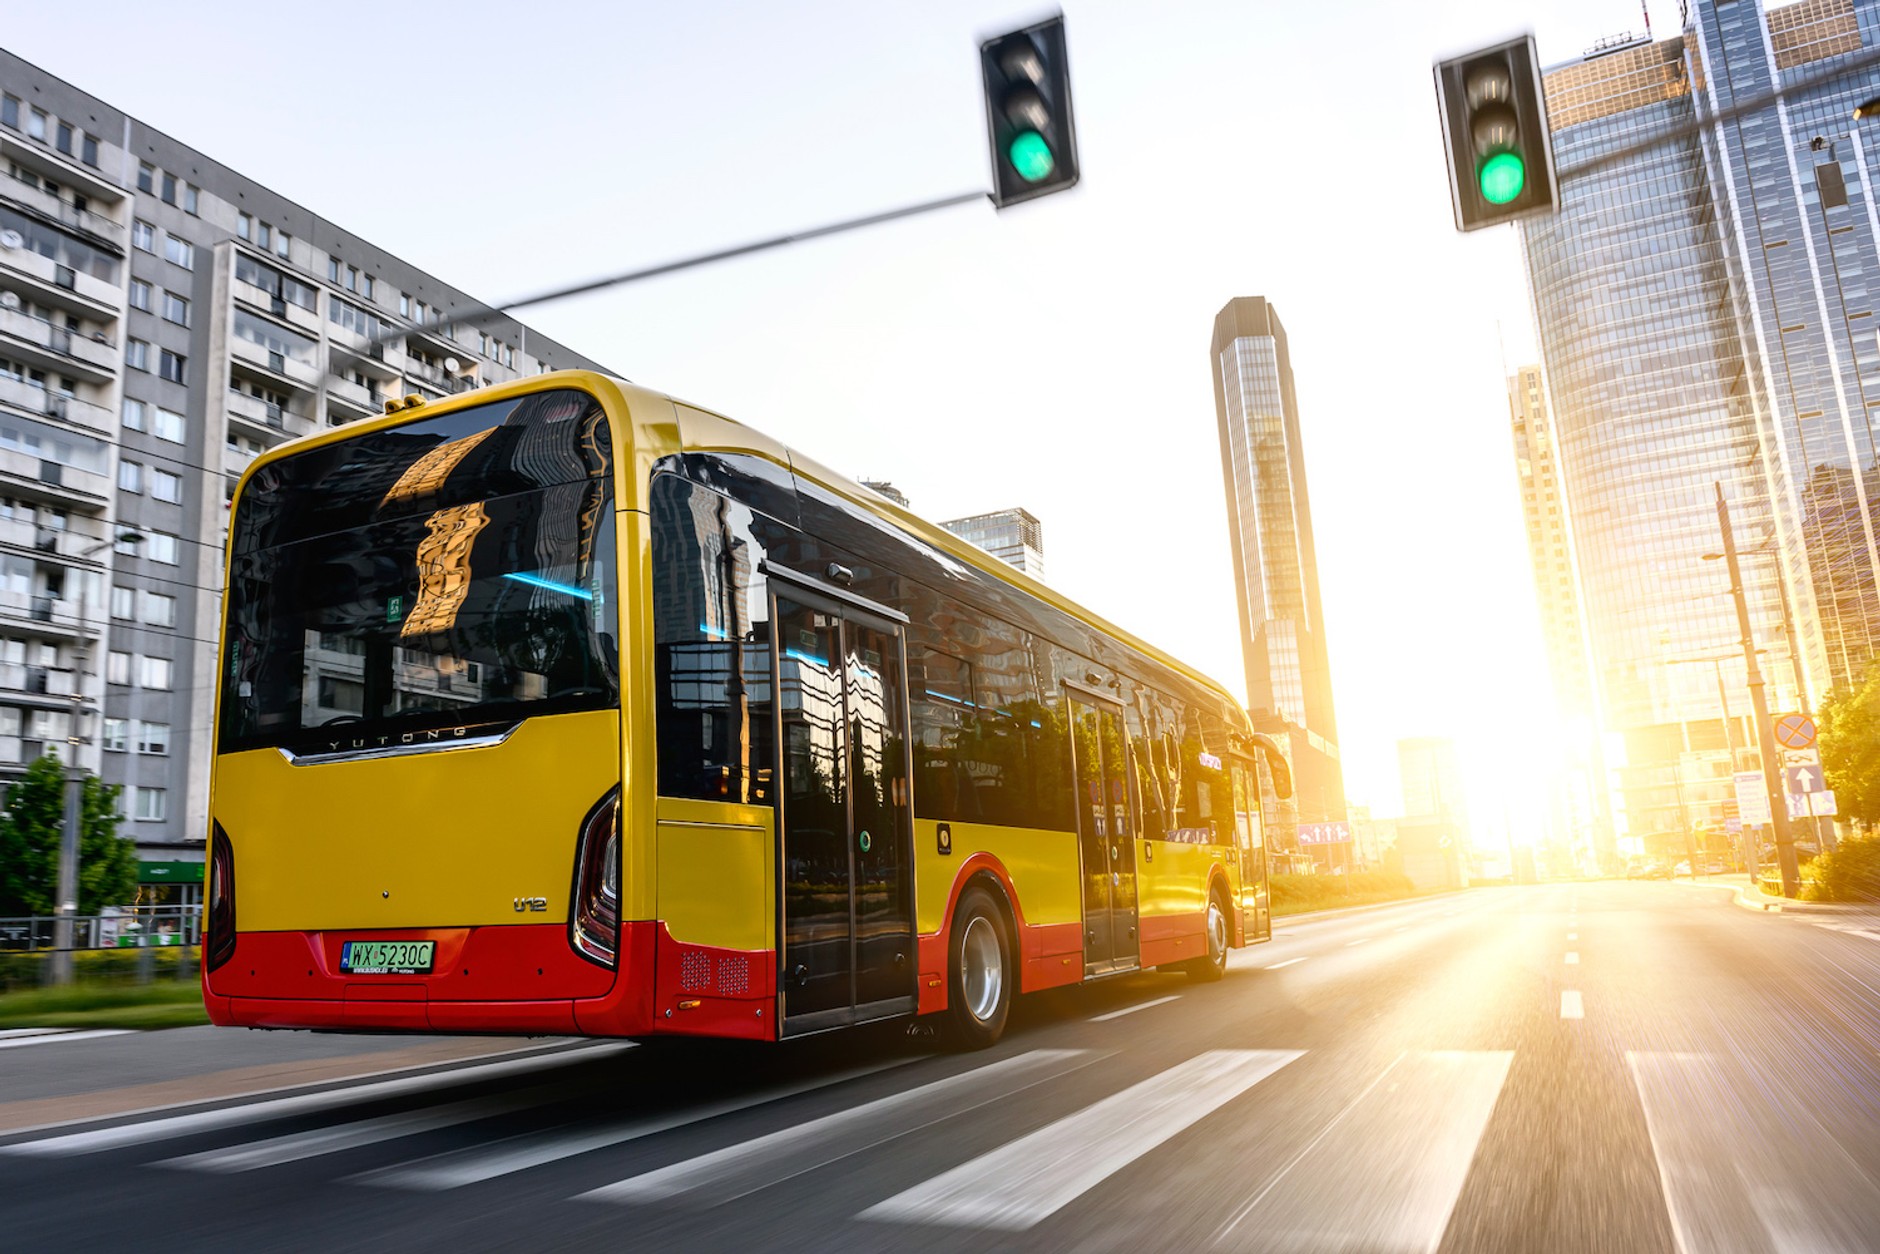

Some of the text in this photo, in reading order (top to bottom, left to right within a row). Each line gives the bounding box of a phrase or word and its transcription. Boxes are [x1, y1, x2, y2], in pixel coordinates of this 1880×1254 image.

[329, 726, 466, 750] YUTONG
[513, 897, 547, 913] U12
[352, 945, 429, 966] WX 5230C
